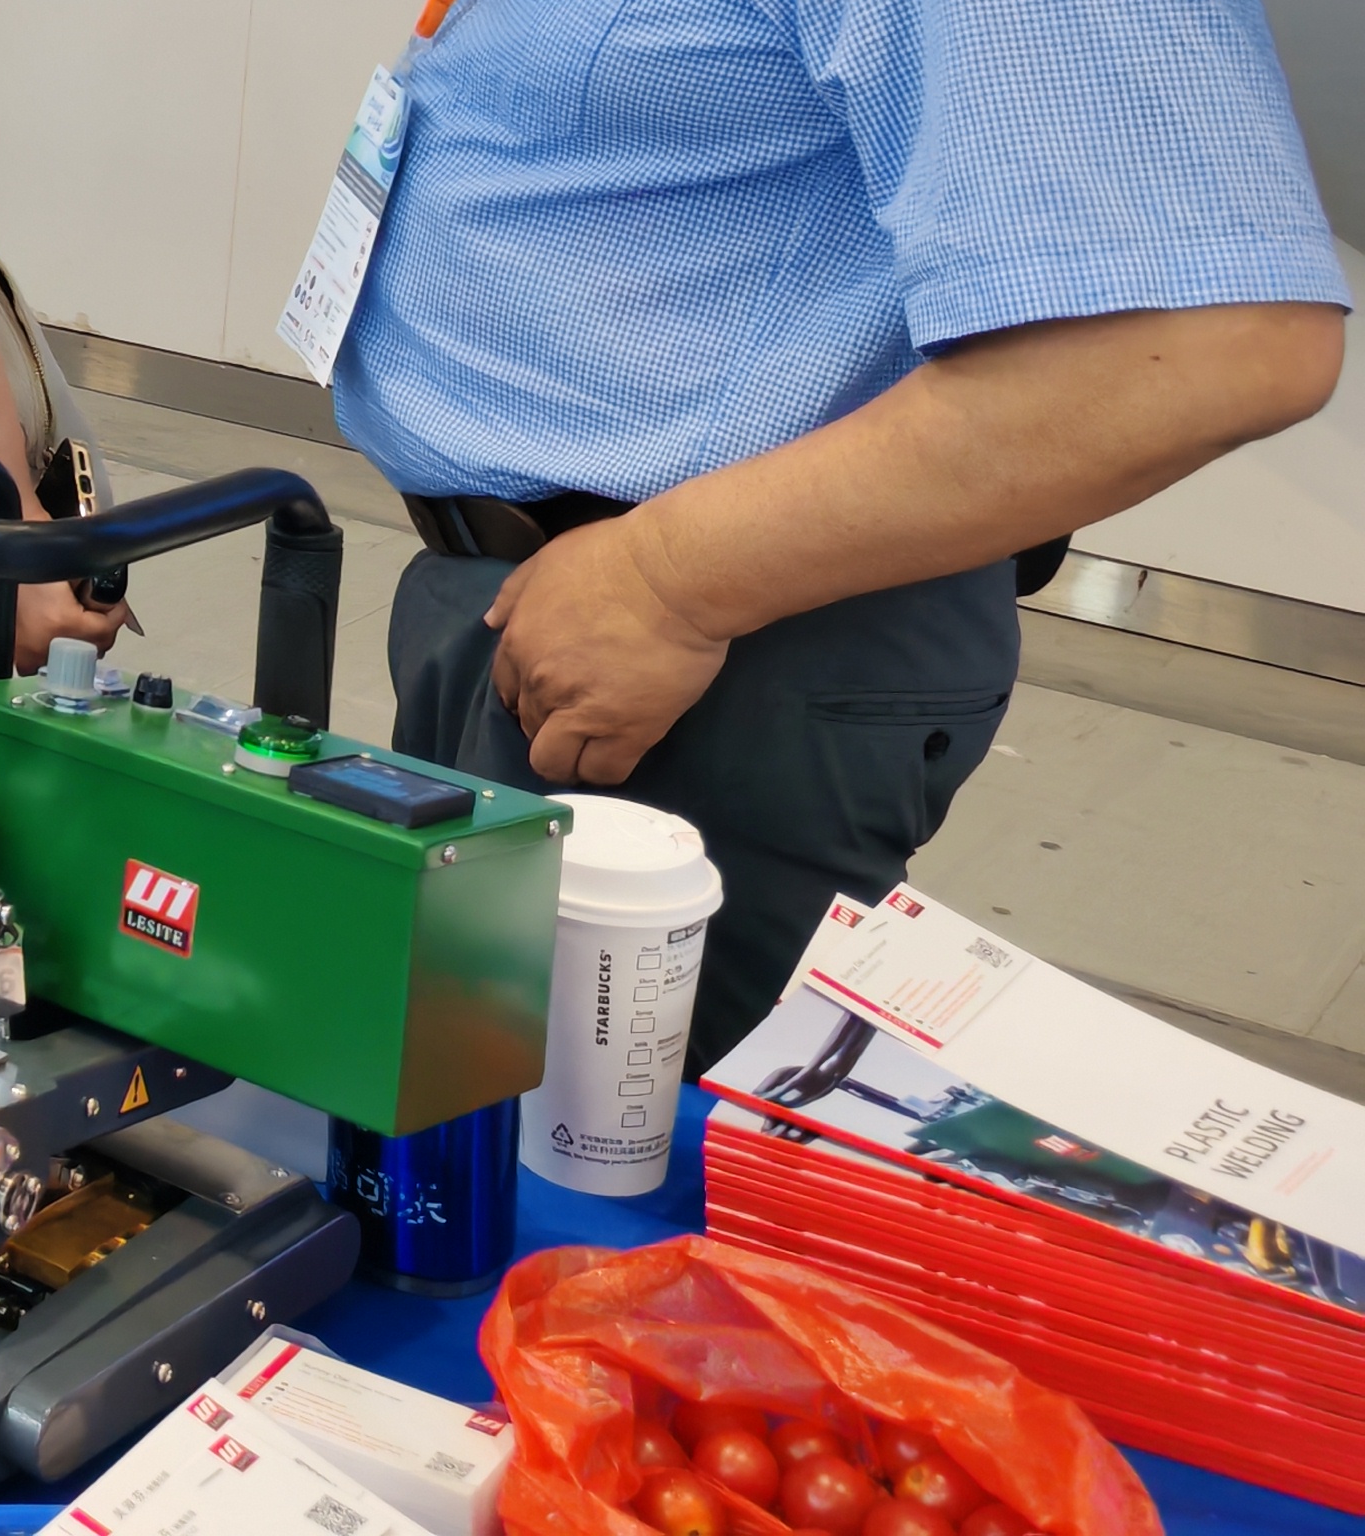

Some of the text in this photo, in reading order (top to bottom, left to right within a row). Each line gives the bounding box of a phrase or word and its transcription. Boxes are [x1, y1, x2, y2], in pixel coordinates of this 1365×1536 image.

[127, 909, 184, 948] LESITE
[595, 950, 613, 1047] STARBUCKS
[1163, 1098, 1250, 1164] PLASTIC
[1212, 1109, 1306, 1180] WELDING
